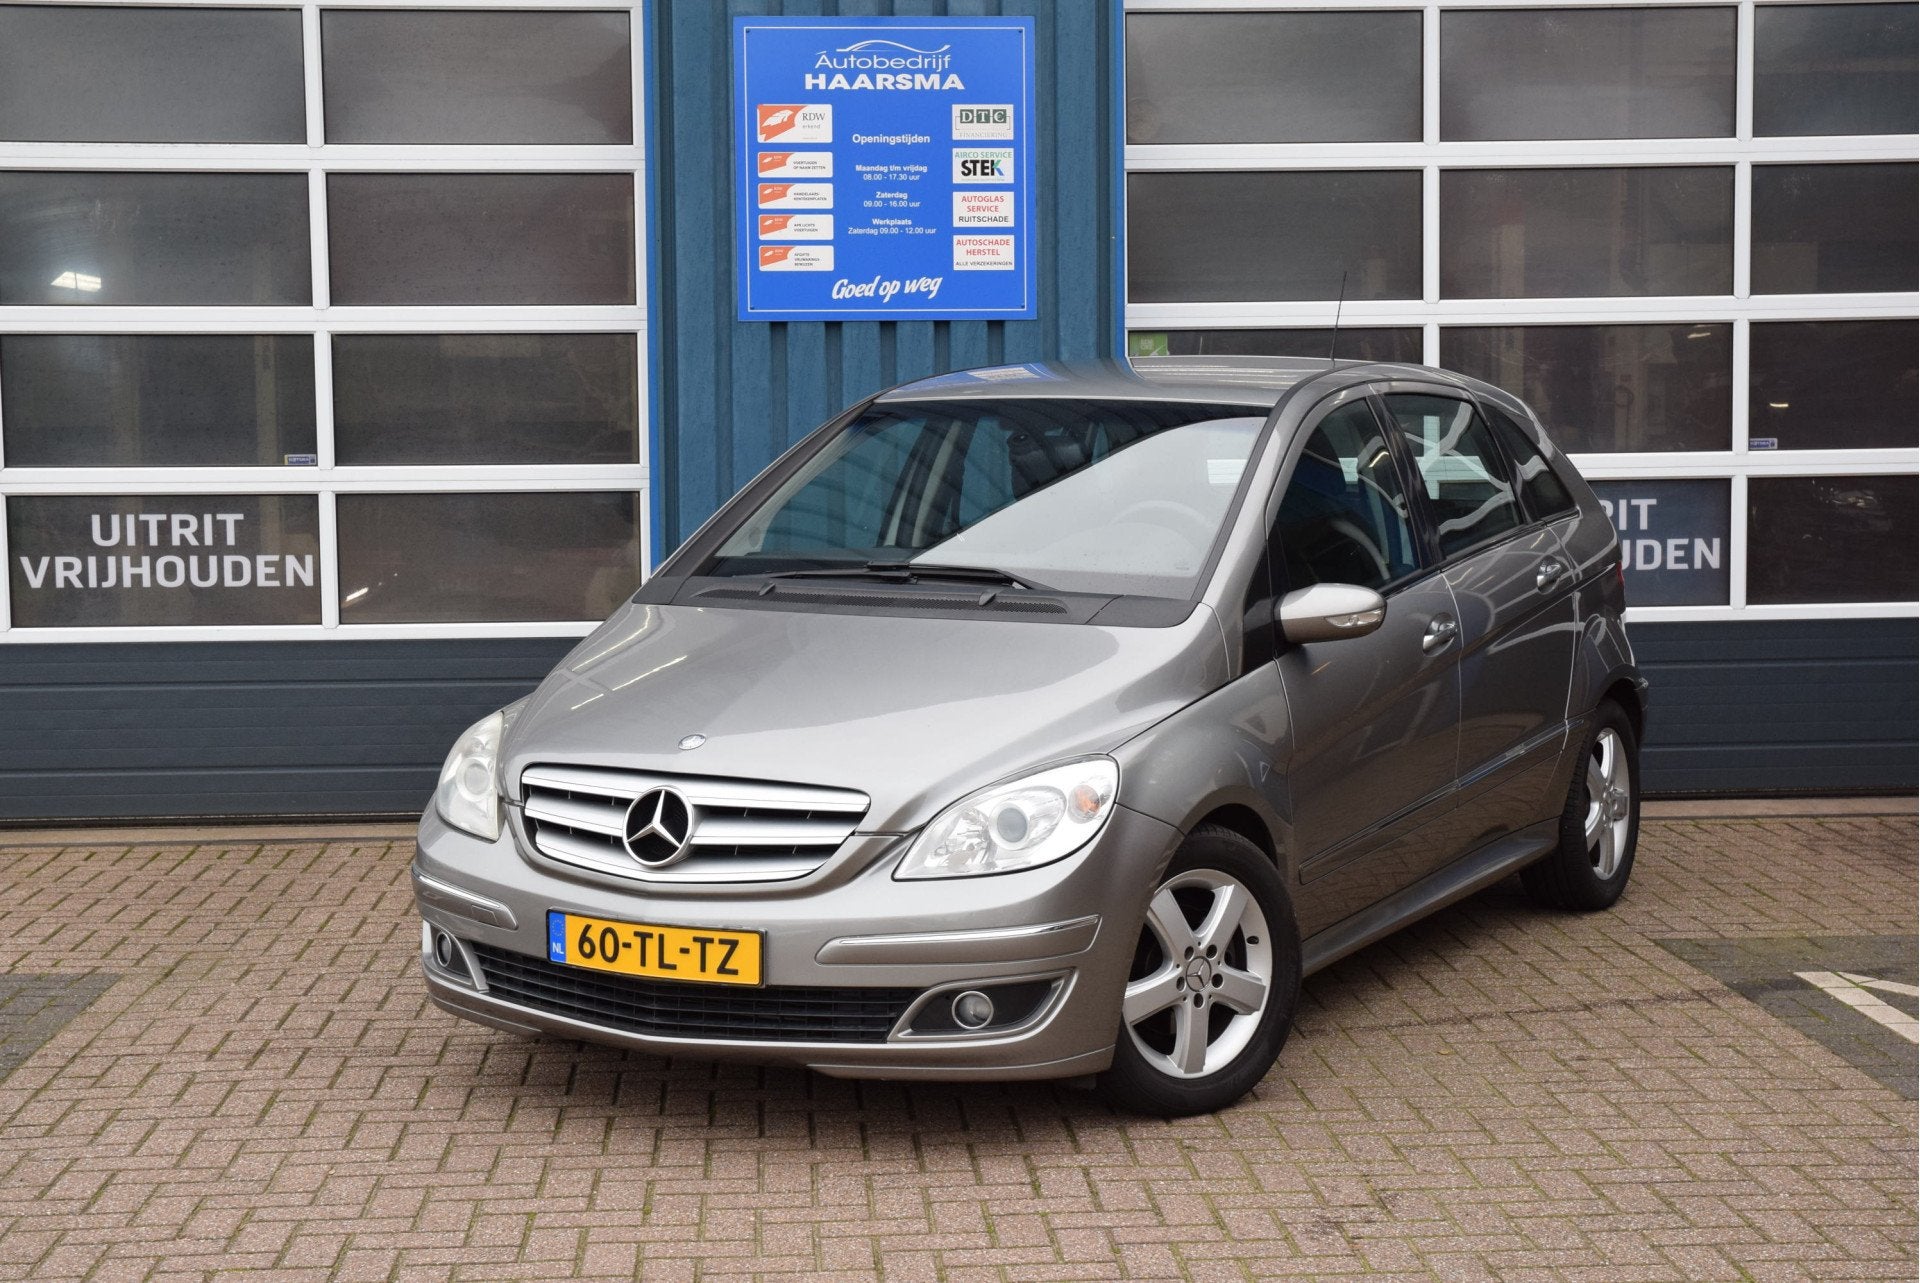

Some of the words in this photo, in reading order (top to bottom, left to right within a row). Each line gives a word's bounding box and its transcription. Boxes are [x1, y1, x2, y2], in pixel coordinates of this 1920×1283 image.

[815, 54, 951, 72] Autobedrijf
[804, 73, 966, 90] HAARSMA
[802, 112, 826, 121] RDW
[960, 109, 1007, 124] DTC
[852, 133, 931, 146] Openingstijden
[955, 151, 979, 159] AIRCO
[980, 151, 1013, 159] SERVICE
[855, 165, 888, 173] Maandag
[902, 165, 928, 173] vrijdag
[961, 159, 1005, 177] STEK
[875, 191, 908, 199] Zaterdag
[961, 195, 1005, 203] AUTOGLAS
[967, 205, 1000, 213] SERVICE
[871, 218, 912, 227] Werkplaats
[958, 215, 1010, 223] RUITSCHADE
[848, 227, 879, 235] Zaterdag
[966, 248, 1001, 256] HERSTEL
[832, 275, 881, 299] Goed
[879, 279, 901, 303] op
[904, 276, 943, 300] weg
[91, 513, 245, 547] UITRIT
[19, 554, 315, 589] VRIJHOUDEN
[552, 941, 565, 955] NL
[577, 923, 740, 976] 60-TL-TZ
